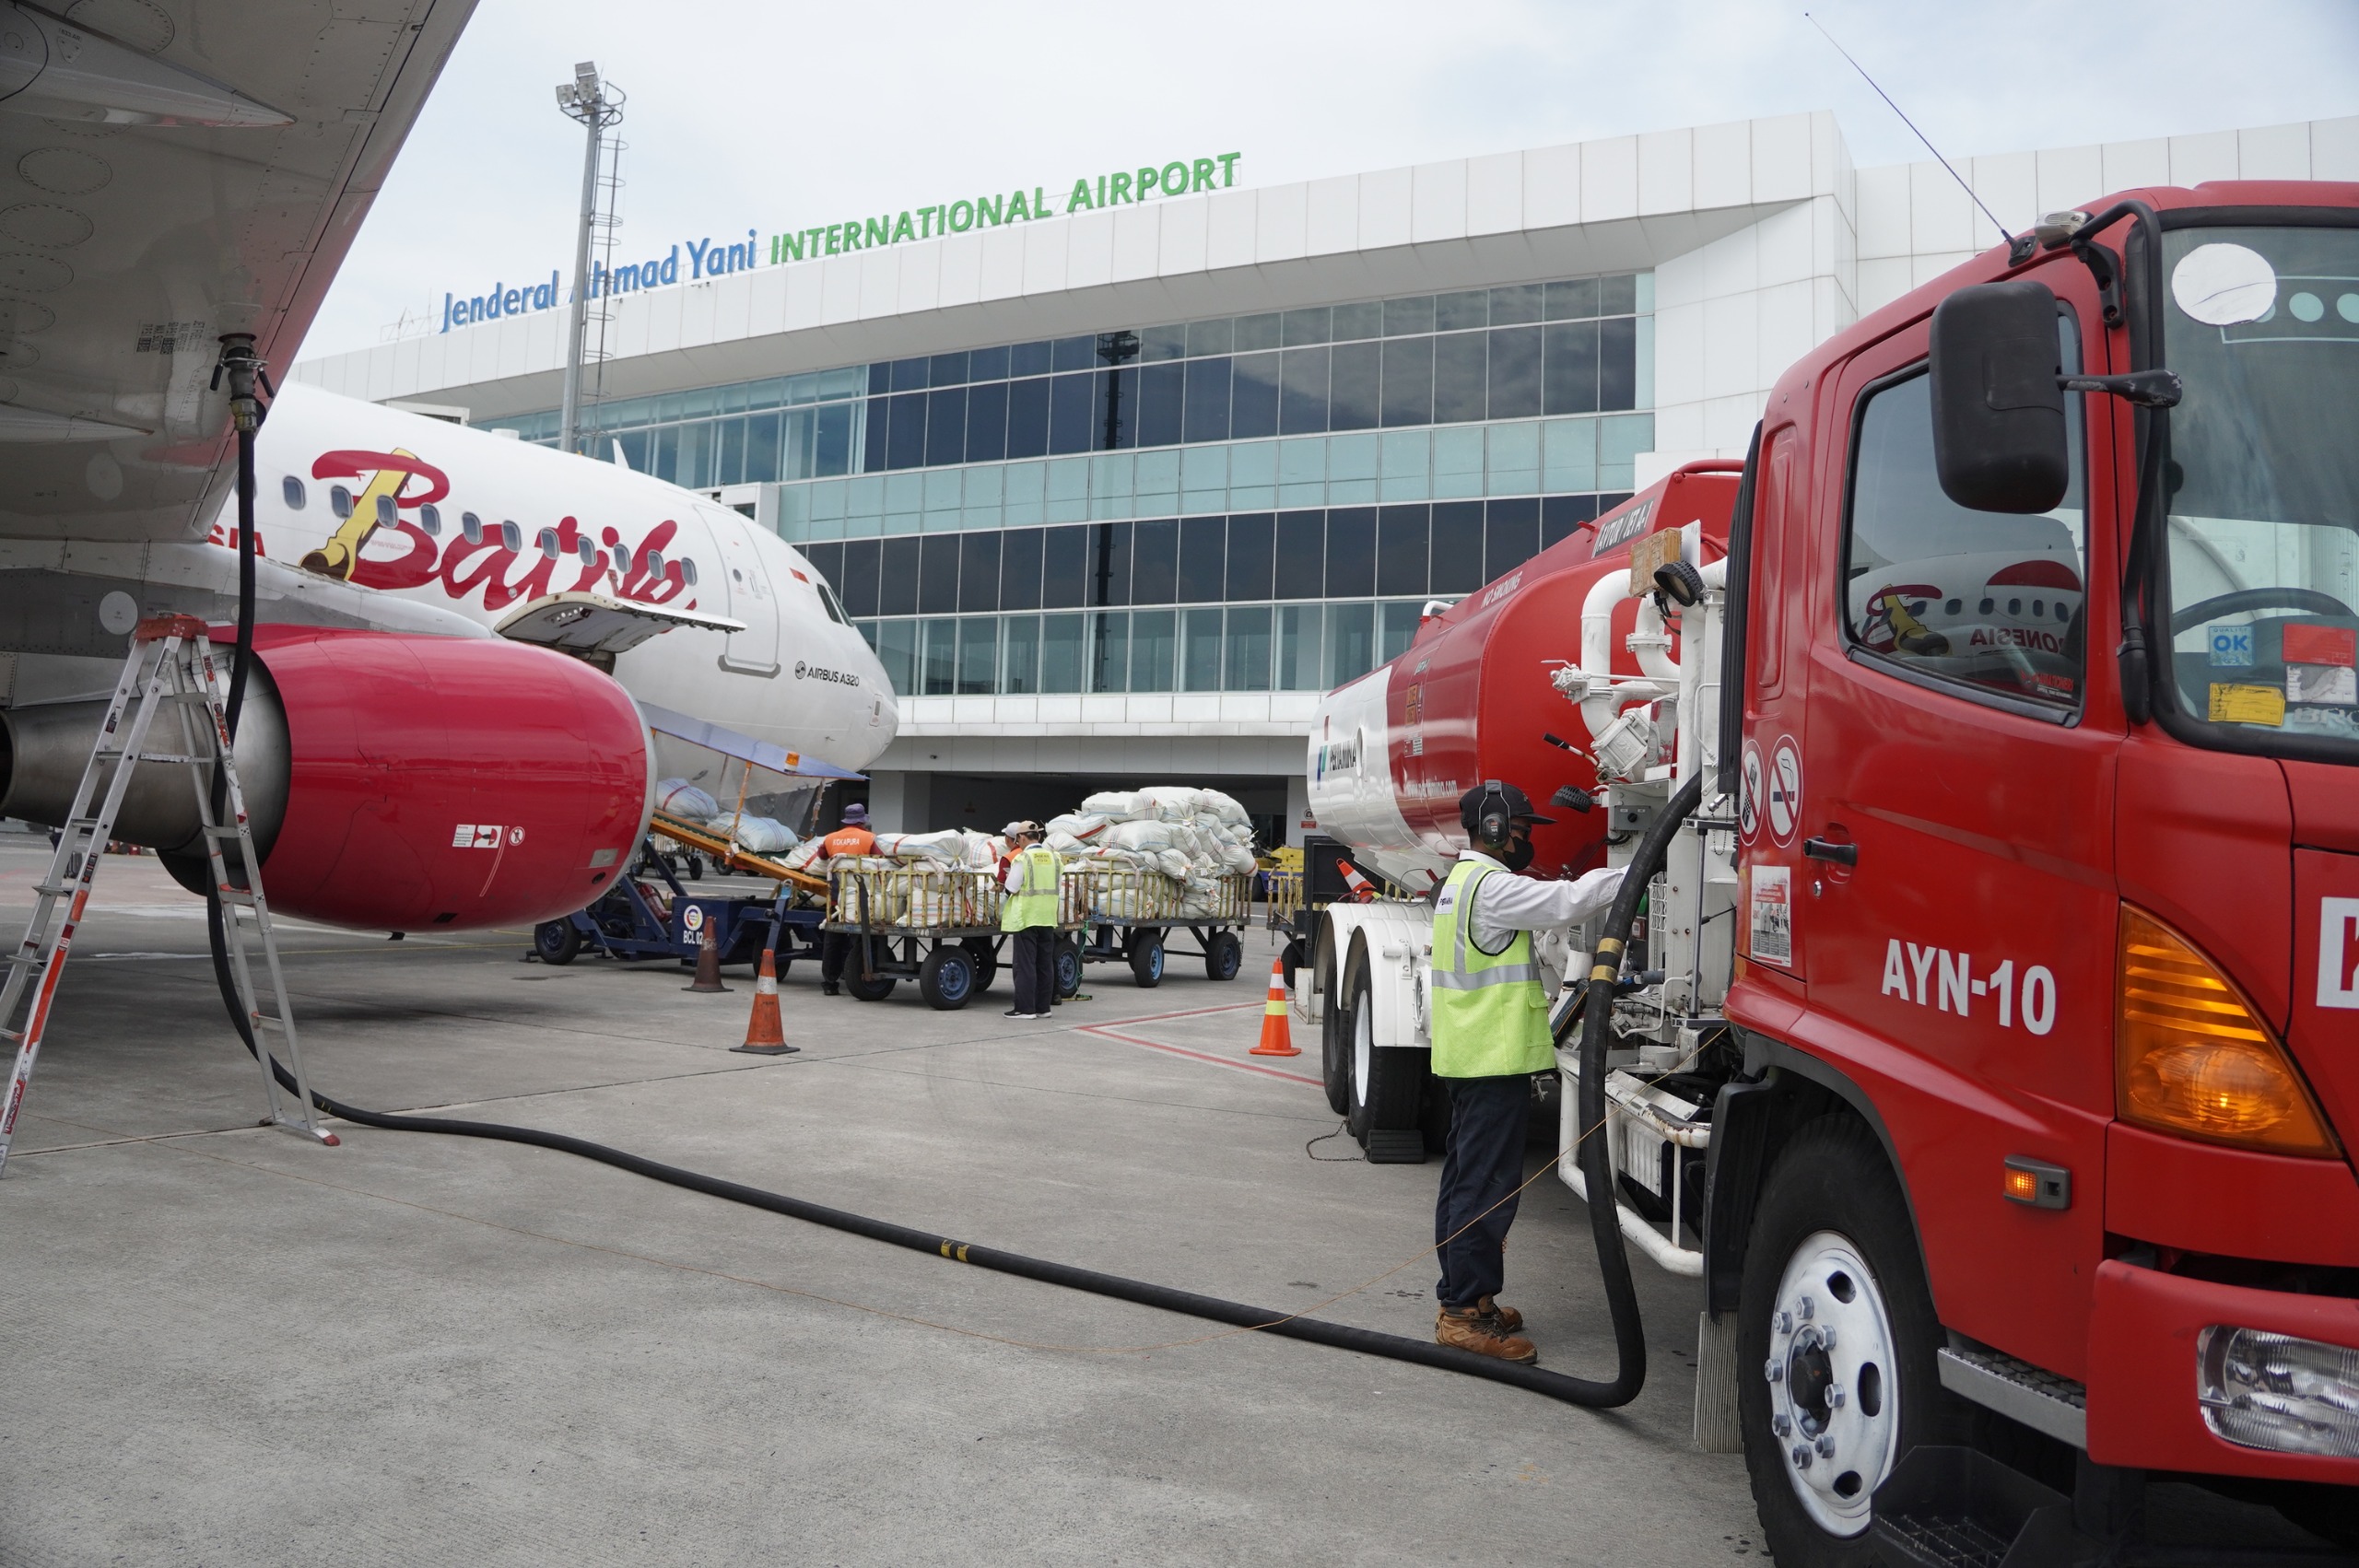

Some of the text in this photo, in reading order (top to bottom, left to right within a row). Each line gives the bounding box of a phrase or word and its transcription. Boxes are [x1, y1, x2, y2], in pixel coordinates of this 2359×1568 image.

[440, 270, 559, 333] Jenderal
[687, 228, 757, 279] Yani
[770, 187, 1051, 265] INTERNATIONAL
[1067, 152, 1241, 213] AIRPORT
[1480, 571, 1523, 609] NO SMOKING
[2213, 635, 2248, 652] OK
[807, 667, 860, 687] AIRBUS A320
[683, 930, 703, 945] BCL 02
[1881, 938, 2057, 1036] AYN-10
